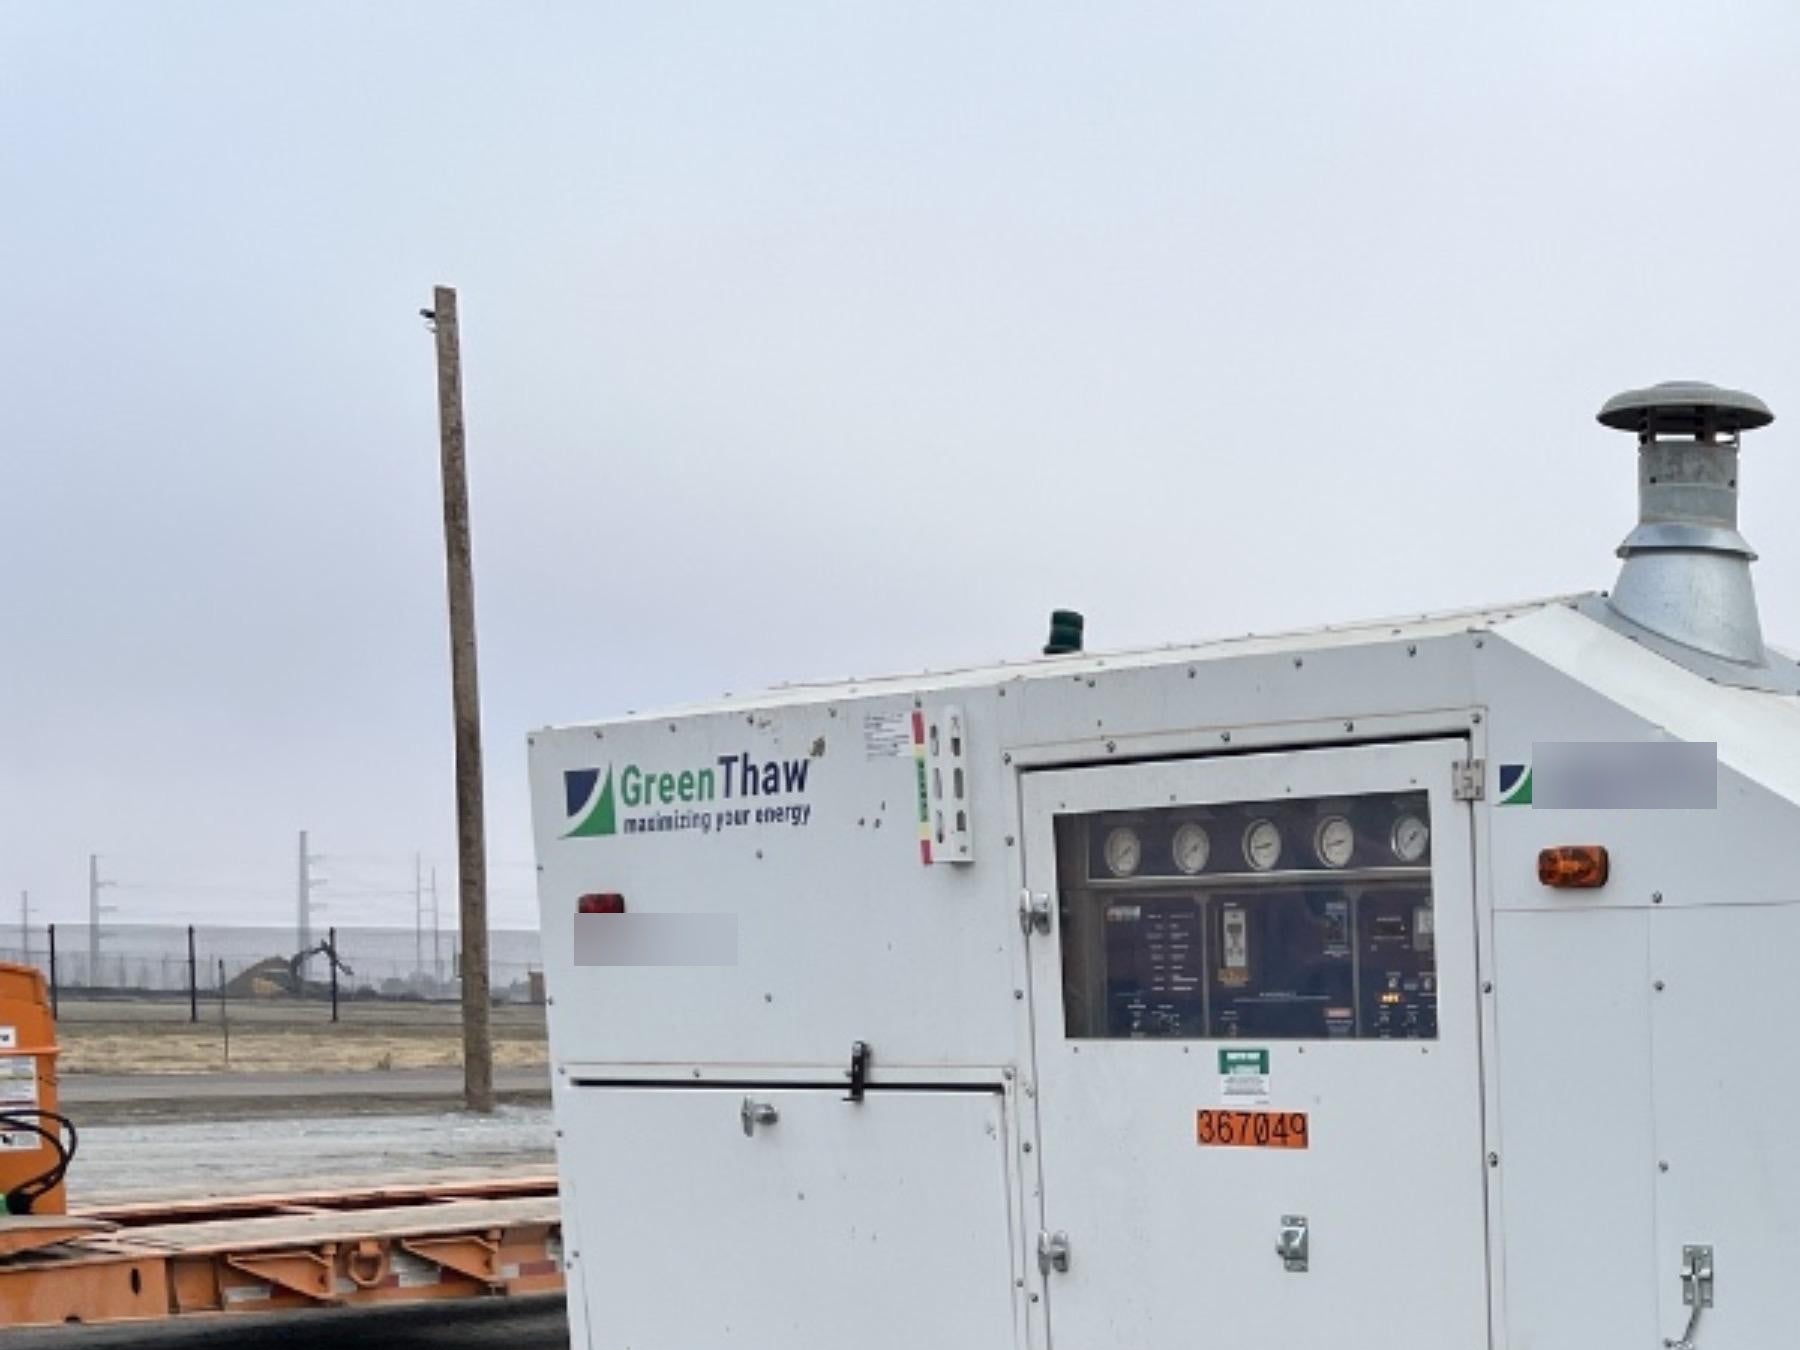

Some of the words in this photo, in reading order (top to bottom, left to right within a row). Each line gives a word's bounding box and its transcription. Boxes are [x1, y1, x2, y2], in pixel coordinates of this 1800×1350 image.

[620, 751, 810, 808] GreenThaw
[622, 808, 713, 835] maximizing
[716, 807, 751, 832] your
[755, 803, 812, 827] energy
[1198, 1109, 1307, 1147] 367049
